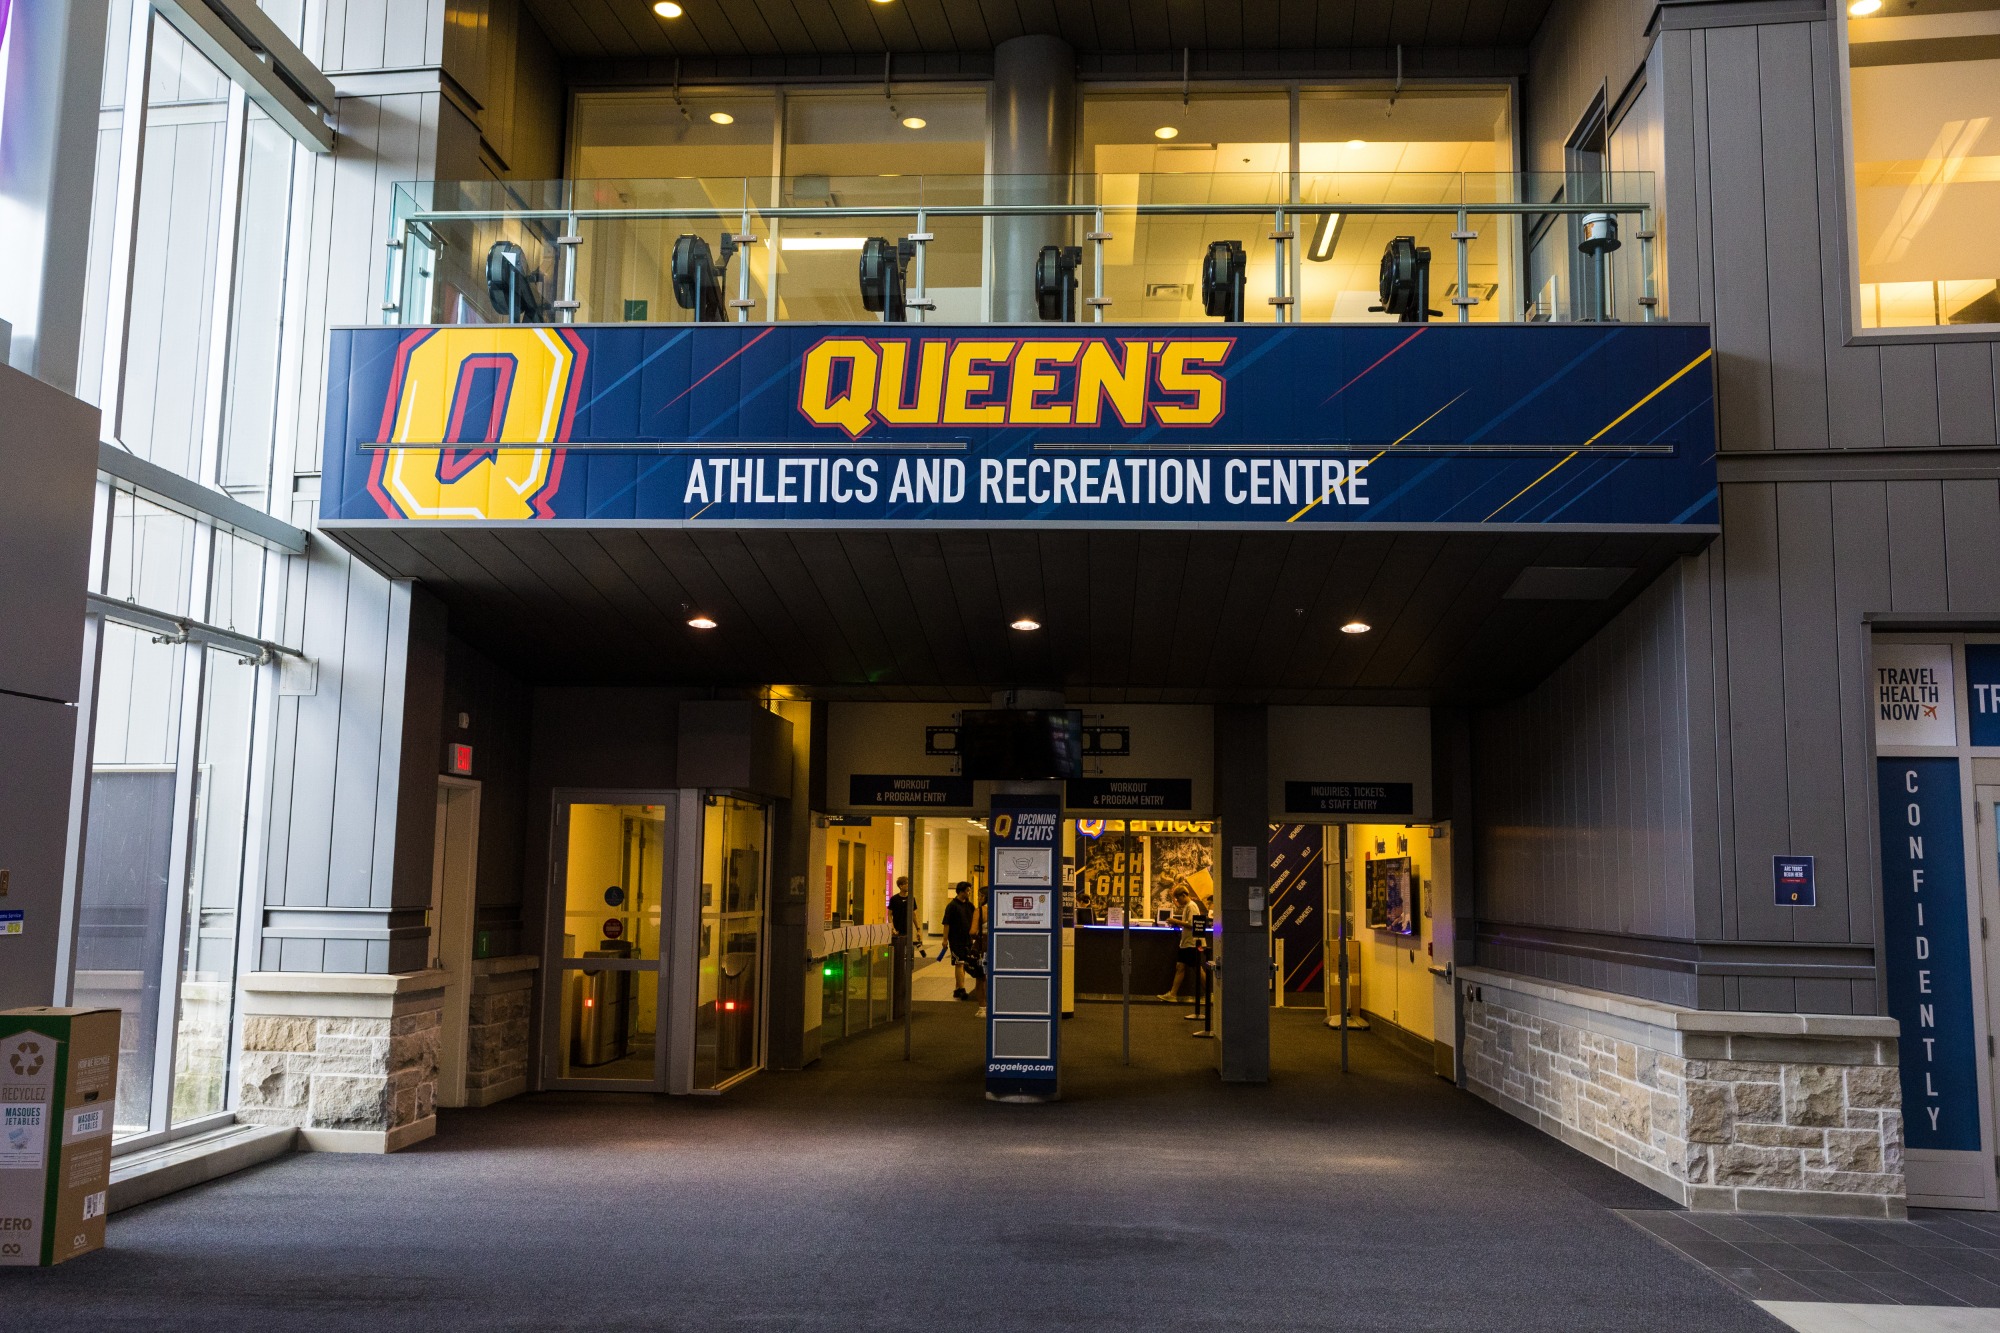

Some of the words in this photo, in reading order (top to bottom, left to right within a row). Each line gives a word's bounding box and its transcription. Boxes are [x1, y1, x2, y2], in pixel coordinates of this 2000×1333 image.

[798, 337, 1237, 440] QUEEN'S
[684, 459, 878, 504] ATHLETICS
[889, 459, 966, 504] AND
[980, 459, 1211, 505] RECREATION
[1225, 459, 1369, 505] CENTRE
[1878, 668, 1938, 685] TRAVEL
[1880, 686, 1939, 702] HEALTH
[1881, 704, 1920, 720] NOW
[894, 779, 931, 790] WORKOUT
[1110, 782, 1148, 793] WORKOUT
[876, 792, 882, 802] &
[884, 791, 921, 802] PROGRAM
[922, 792, 947, 802] ENTRY
[1311, 786, 1352, 797] INQUIRIES,
[1354, 786, 1387, 798] TICKETS,
[1093, 795, 1099, 805] &
[1101, 794, 1139, 805] PROGRAM
[1140, 795, 1165, 806] ENTRY
[1320, 800, 1327, 809] &
[1328, 800, 1351, 809] STAFF
[1353, 800, 1378, 810] ENTRY
[1017, 813, 1057, 825] UPCOMING
[1014, 825, 1055, 841] EVENTS
[1905, 770, 1940, 1131] CONFIDENTLY
[988, 1062, 1054, 1073] gogaelsgo.com
[1, 1087, 46, 1101] RECYCLEZ
[5, 1107, 41, 1117] MASQUES
[78, 1111, 99, 1123] MASQUES
[4, 1117, 40, 1126] JETABLES
[77, 1121, 98, 1133] JETABLES
